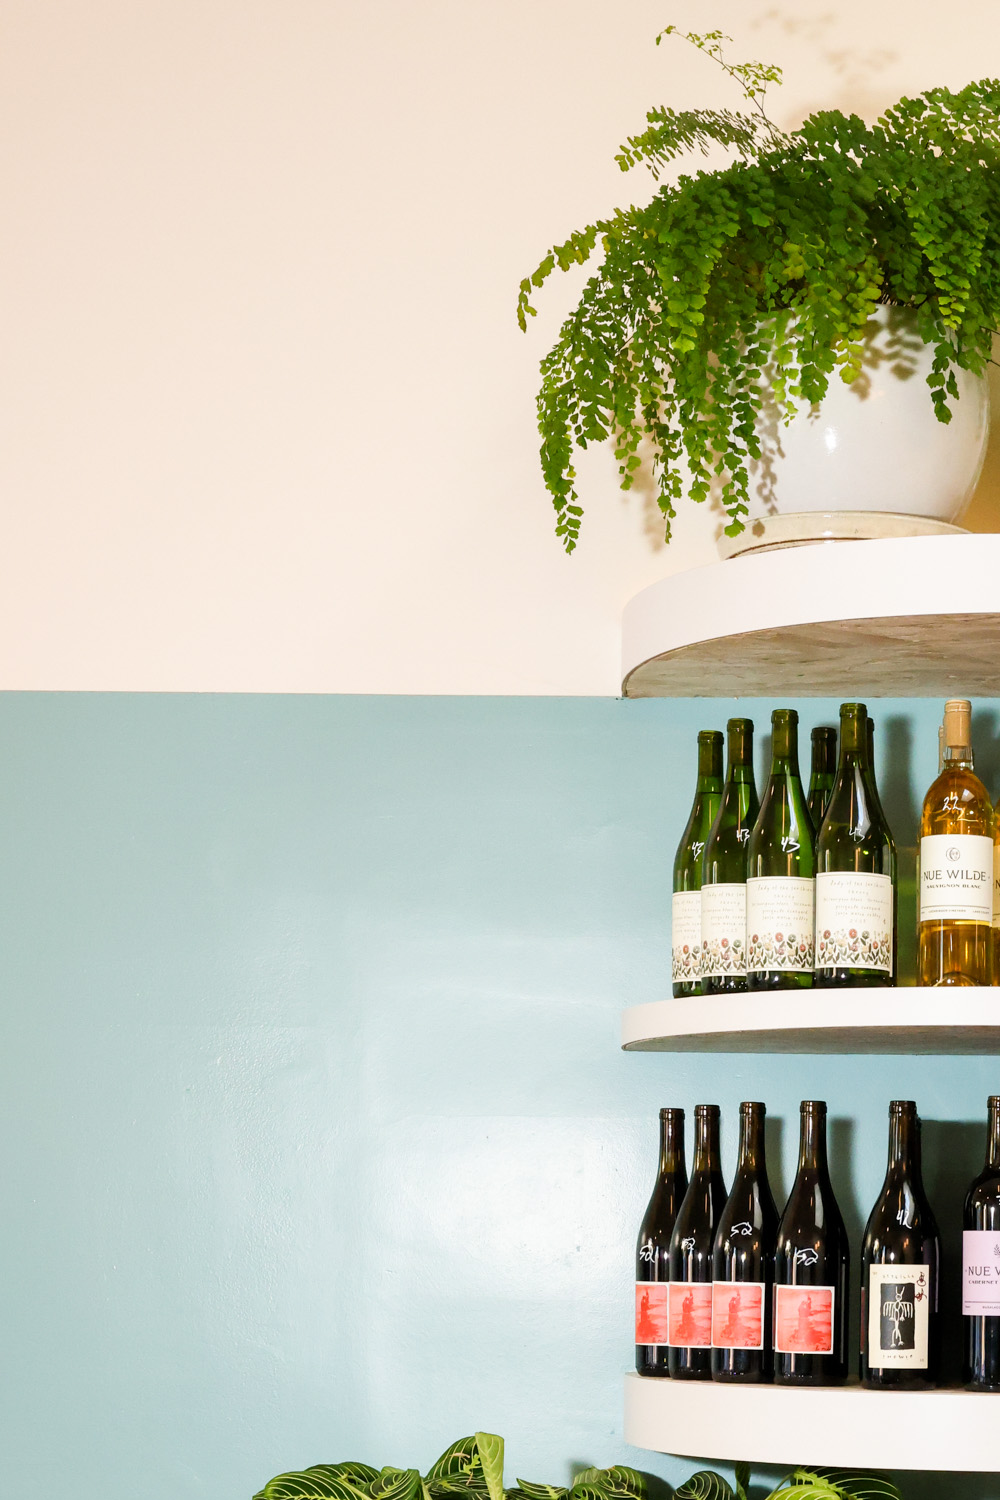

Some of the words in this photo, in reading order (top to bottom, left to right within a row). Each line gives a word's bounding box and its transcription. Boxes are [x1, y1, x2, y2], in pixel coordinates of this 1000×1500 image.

[943, 796, 962, 811] 22
[781, 836, 800, 852] 43
[924, 870, 942, 881] NUE
[947, 870, 986, 881] WILDE
[968, 1266, 991, 1276] NUE
